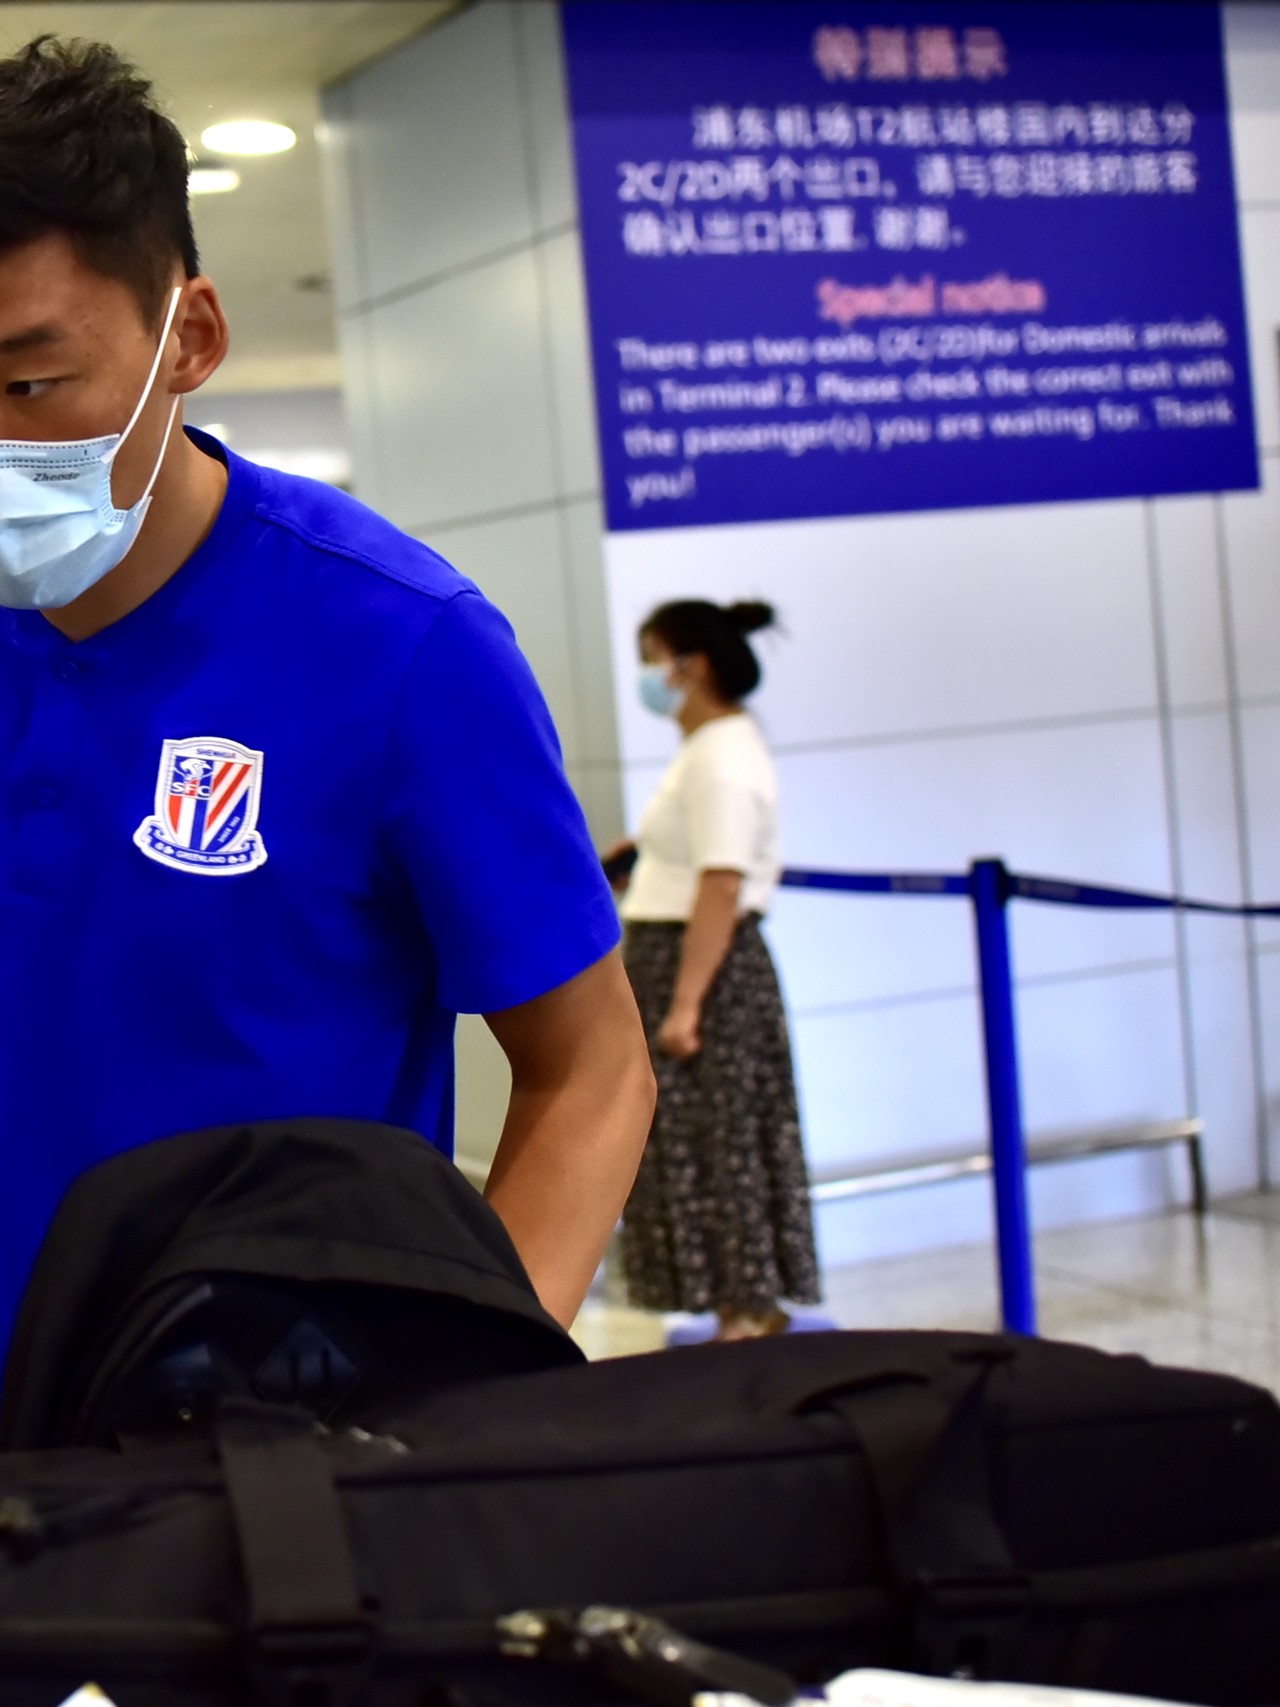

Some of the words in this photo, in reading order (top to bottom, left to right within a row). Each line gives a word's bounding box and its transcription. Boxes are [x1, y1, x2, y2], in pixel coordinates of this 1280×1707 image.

[818, 275, 934, 326] Special
[942, 272, 1045, 314] notice
[619, 336, 699, 370] There
[703, 340, 750, 367] are
[753, 336, 811, 365] two
[813, 333, 875, 364] exits
[1022, 321, 1135, 354] Domestic
[1141, 315, 1227, 349] arrivals
[620, 381, 652, 413] in
[658, 372, 782, 412] Terminal
[817, 371, 902, 404] Please
[904, 365, 979, 400] check
[984, 363, 1030, 397] the
[1032, 361, 1122, 394] correct
[1125, 360, 1172, 391] exit
[1177, 356, 1234, 388] with
[624, 424, 678, 459] the
[683, 412, 872, 460] passenger(s)
[876, 416, 931, 452] you
[936, 412, 983, 441] are
[990, 404, 1094, 441] waiting
[1154, 394, 1235, 428] Thank
[34, 472, 80, 481] Zhende
[172, 782, 210, 796] SFC
